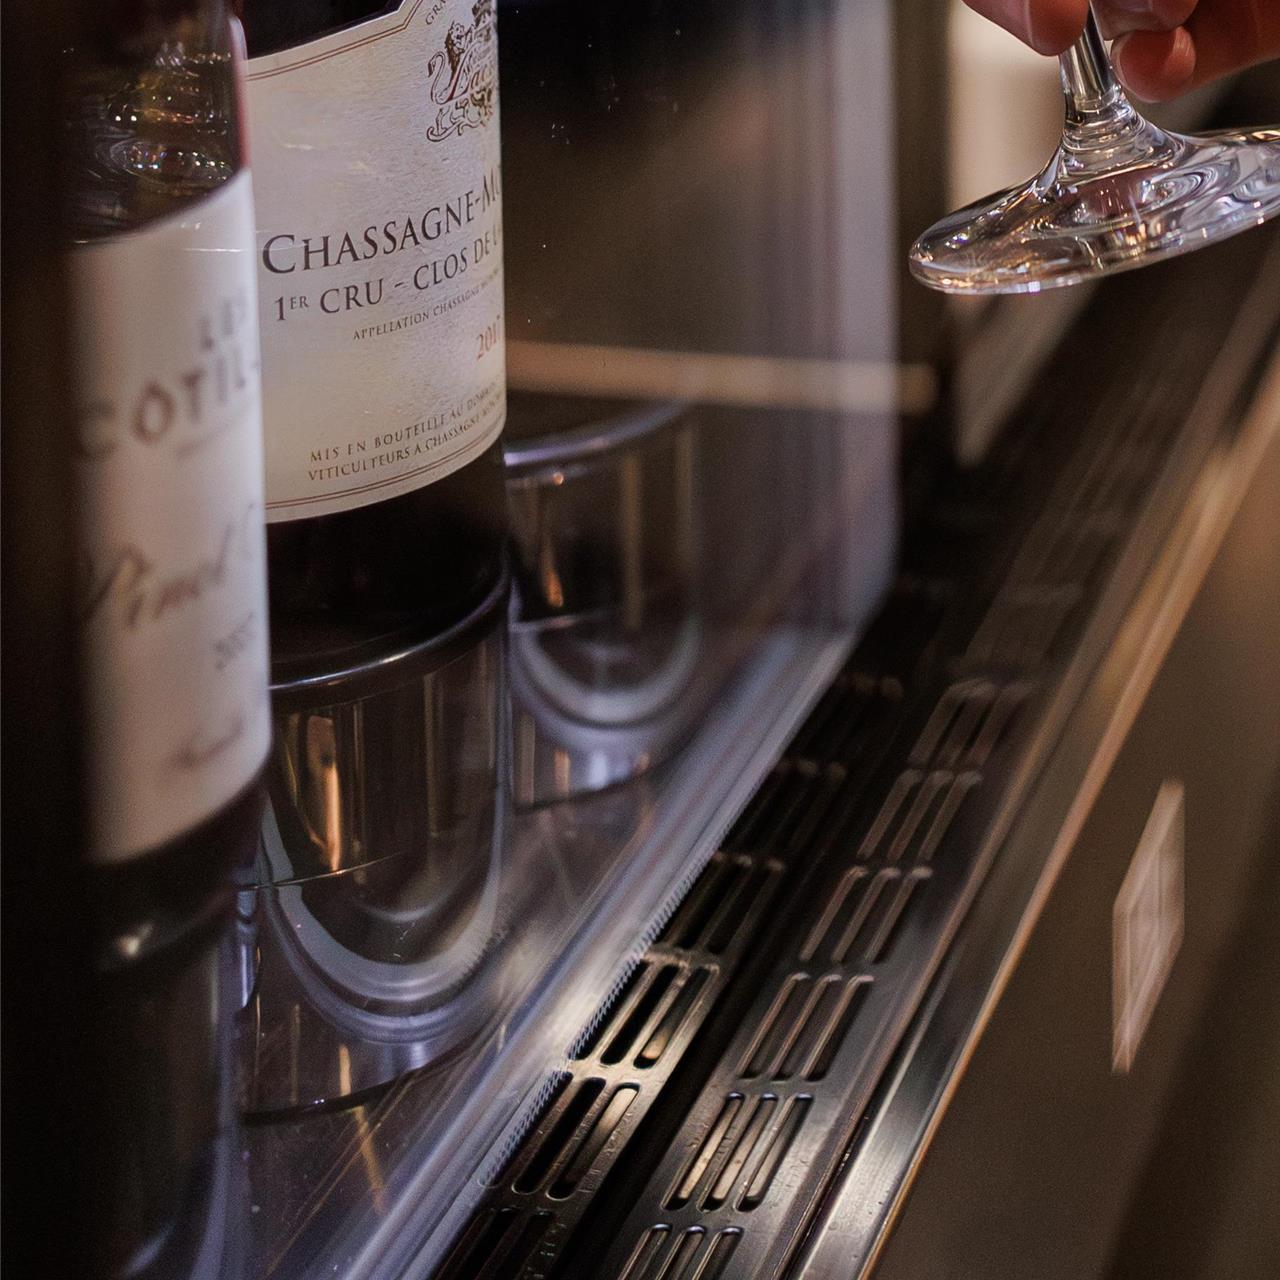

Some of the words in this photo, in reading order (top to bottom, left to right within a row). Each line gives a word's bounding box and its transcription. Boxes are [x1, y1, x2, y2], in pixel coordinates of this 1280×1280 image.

[320, 278, 384, 314] CRU
[413, 246, 468, 290] CLOS
[353, 308, 430, 340] APPELLATION
[311, 446, 340, 462] MIS
[374, 414, 445, 449] BOUTEILLE
[309, 446, 411, 481] VITICULTEURS
